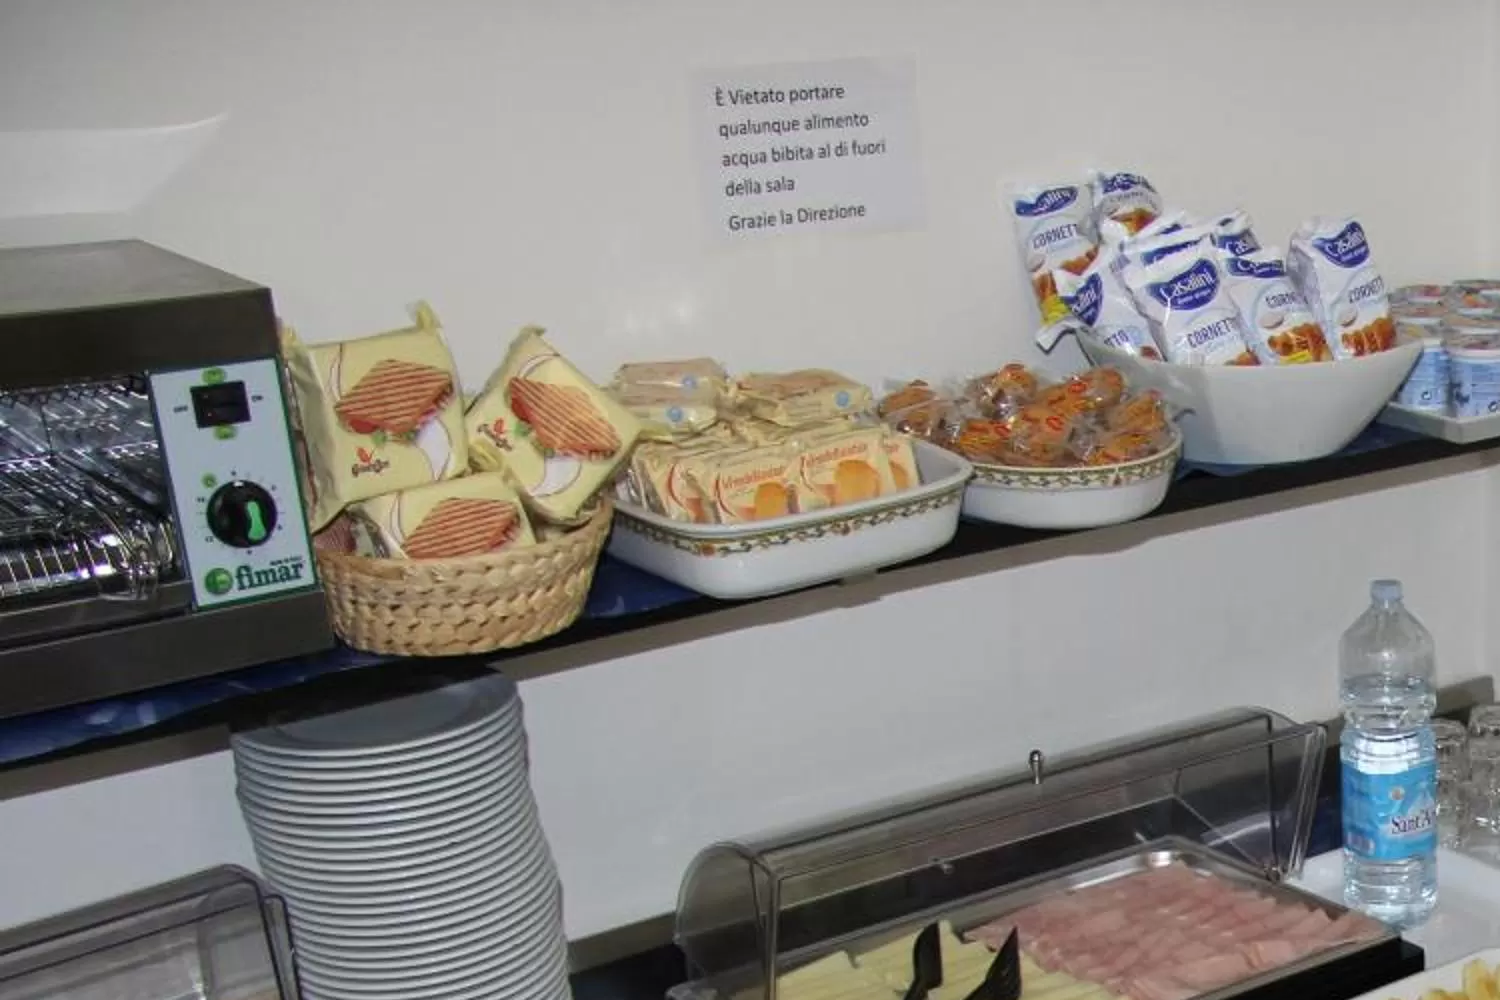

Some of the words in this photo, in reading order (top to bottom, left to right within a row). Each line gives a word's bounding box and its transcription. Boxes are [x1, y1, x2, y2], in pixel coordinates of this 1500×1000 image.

[728, 88, 786, 105] Vietato
[789, 84, 845, 104] portare
[719, 120, 800, 140] qualunque
[804, 113, 870, 131] alimento
[722, 150, 767, 168] acqua
[771, 146, 815, 163] bibita
[818, 144, 831, 159] al
[835, 142, 849, 157] di
[852, 139, 886, 157] fuori
[725, 178, 762, 197] della
[766, 176, 796, 192] sala
[728, 212, 777, 231] Grazie
[780, 211, 794, 225] la
[797, 203, 866, 224] Direzione
[235, 563, 303, 590] fimar
